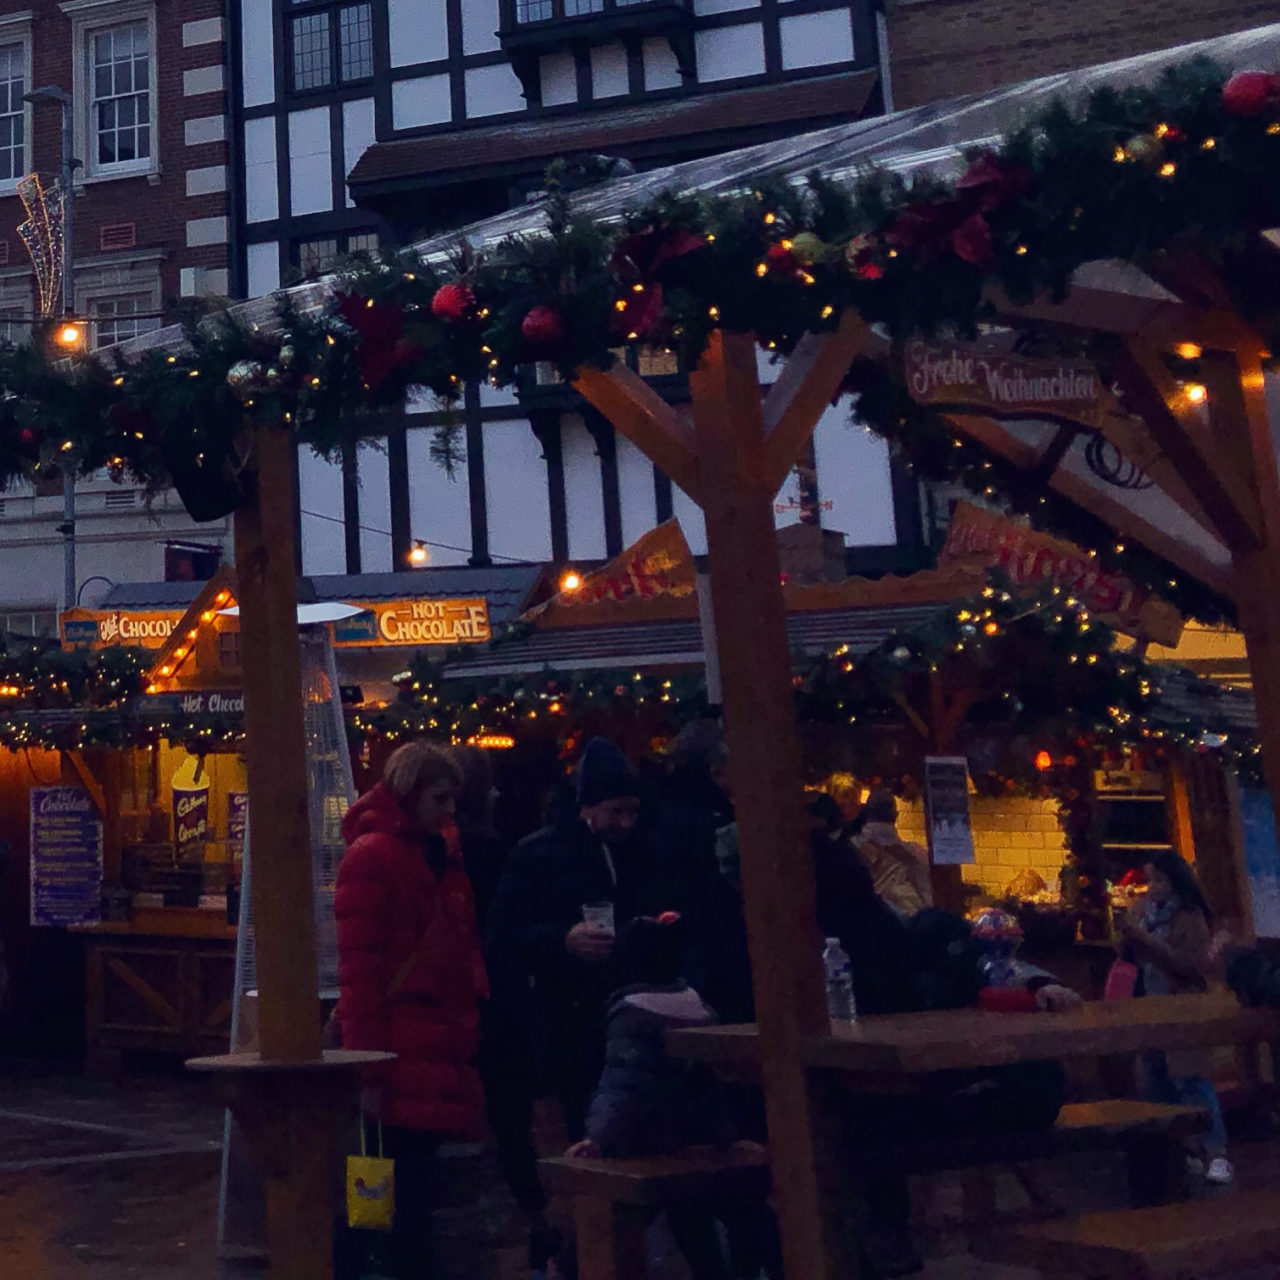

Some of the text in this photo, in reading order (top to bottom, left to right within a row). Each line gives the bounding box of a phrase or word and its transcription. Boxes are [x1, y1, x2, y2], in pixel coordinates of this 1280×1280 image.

[912, 340, 976, 394] Frohe
[411, 603, 447, 619] HOT
[119, 616, 180, 639] CHOCOL
[380, 605, 489, 642] CHOCOLATE
[181, 694, 205, 714] Hot
